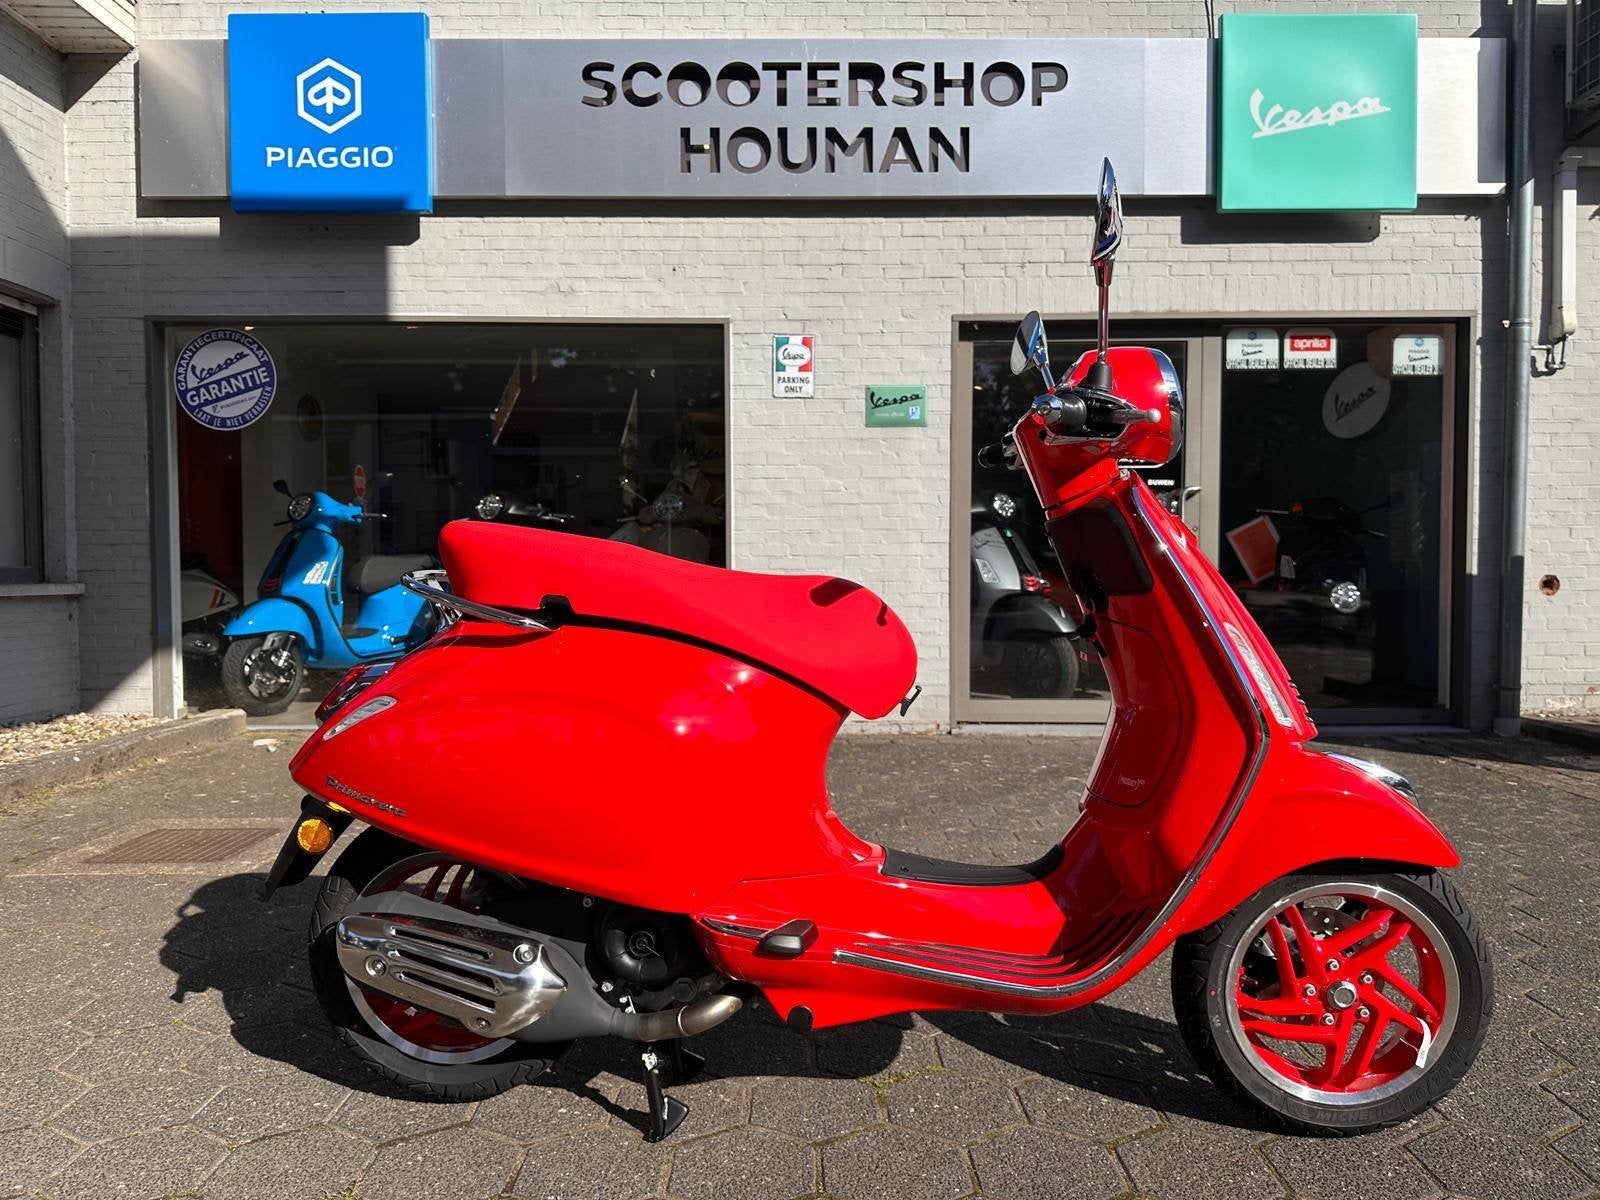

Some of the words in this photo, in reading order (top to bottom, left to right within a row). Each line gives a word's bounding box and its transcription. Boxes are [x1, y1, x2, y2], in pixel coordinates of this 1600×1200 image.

[581, 61, 1069, 107] SCOOTERSHOP
[1249, 88, 1391, 139] Vespa
[265, 146, 394, 168] PIAGGIO
[680, 126, 970, 174] HOUMAN
[782, 347, 806, 360] Vespa
[1294, 337, 1328, 350] aprilia
[178, 331, 269, 390] GARANTIECERTIFICAAT
[190, 351, 250, 384] Vespa
[186, 367, 270, 406] GARANTIE
[777, 376, 810, 384] PARKING
[784, 385, 803, 393] ONLY
[870, 391, 923, 409] Vespa
[1334, 386, 1377, 423] Vespa
[194, 408, 211, 423] LAAT
[226, 416, 243, 427] NIET
[325, 775, 406, 817] Primavera
